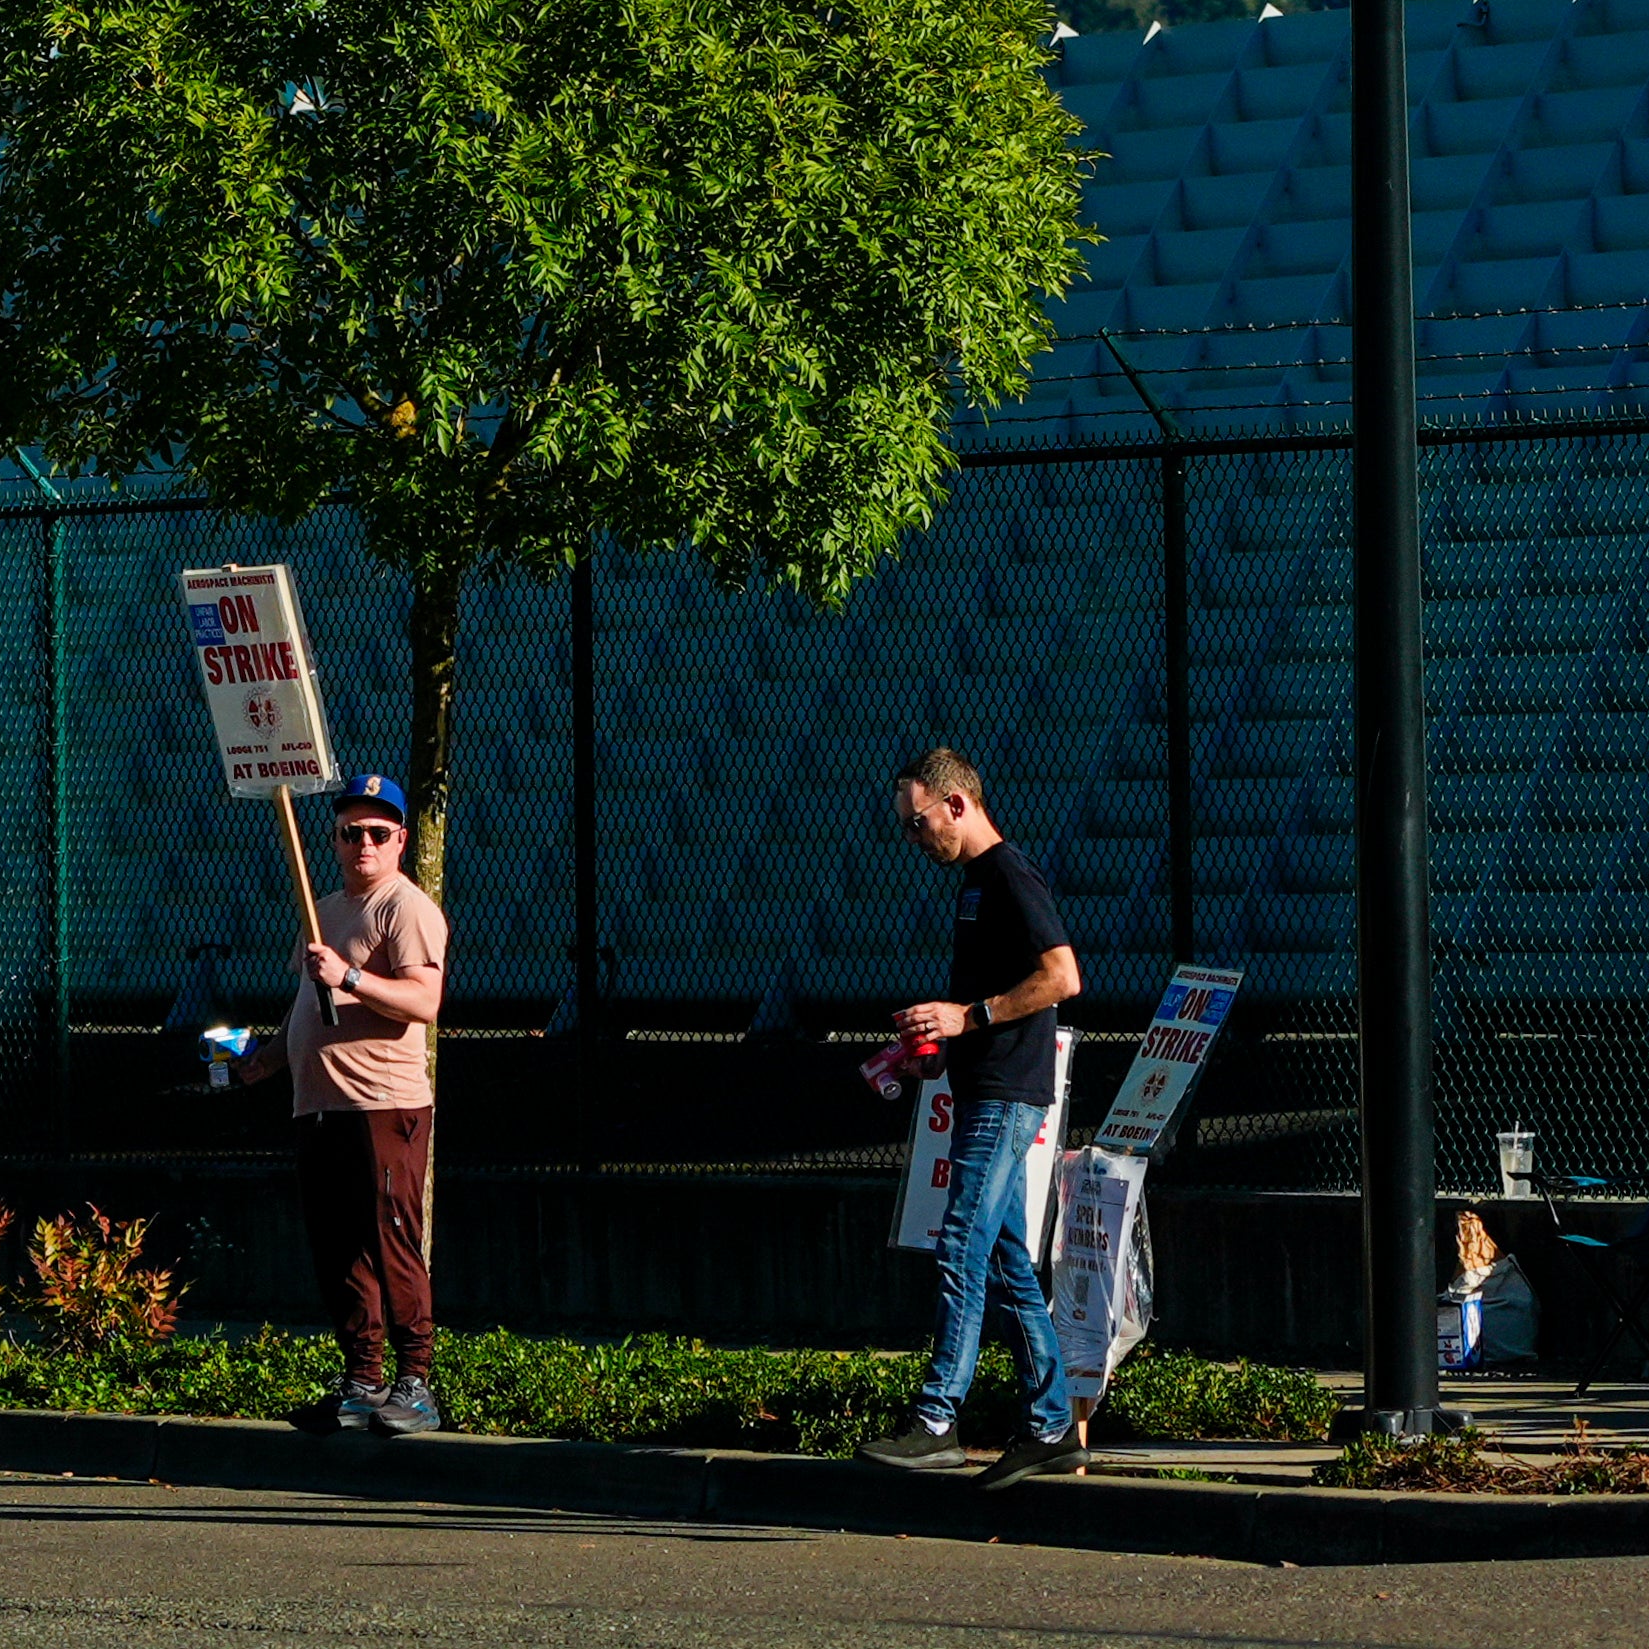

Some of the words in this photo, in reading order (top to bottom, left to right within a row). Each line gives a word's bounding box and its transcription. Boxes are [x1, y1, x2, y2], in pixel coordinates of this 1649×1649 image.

[187, 578, 229, 590] AEROSPACE
[230, 573, 275, 587] MACHINISTS
[219, 595, 260, 634] ON
[204, 642, 298, 685] STRIKE
[281, 741, 312, 752] AFL-CIO
[233, 763, 253, 779] AT
[257, 759, 320, 778] BOEING
[1178, 988, 1213, 1022] ON
[1141, 1026, 1213, 1064] STRIKE
[1102, 1123, 1120, 1137] AT
